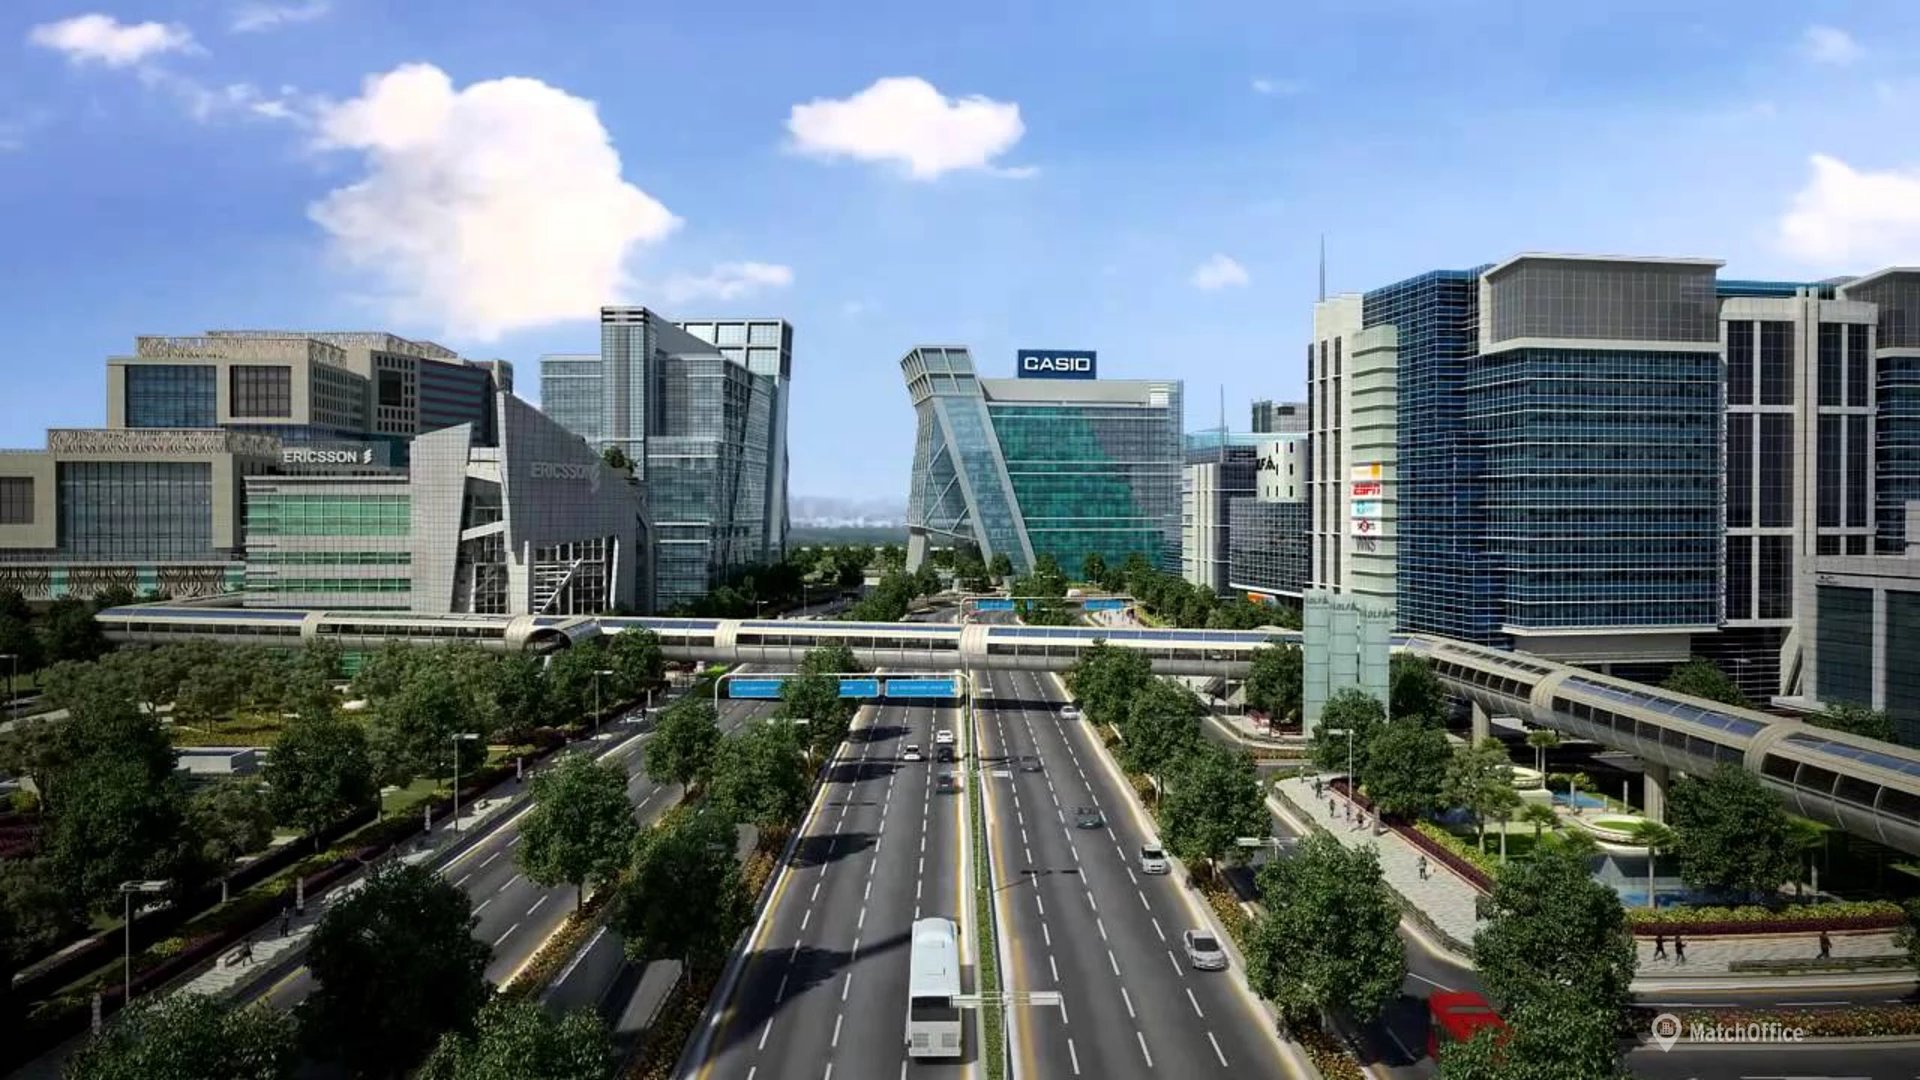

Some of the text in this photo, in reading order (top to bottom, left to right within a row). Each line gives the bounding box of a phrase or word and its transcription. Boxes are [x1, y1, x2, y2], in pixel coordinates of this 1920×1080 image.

[1024, 357, 1091, 371] CASIO
[283, 450, 357, 463] ERICSSON
[1353, 482, 1381, 496] ESPN
